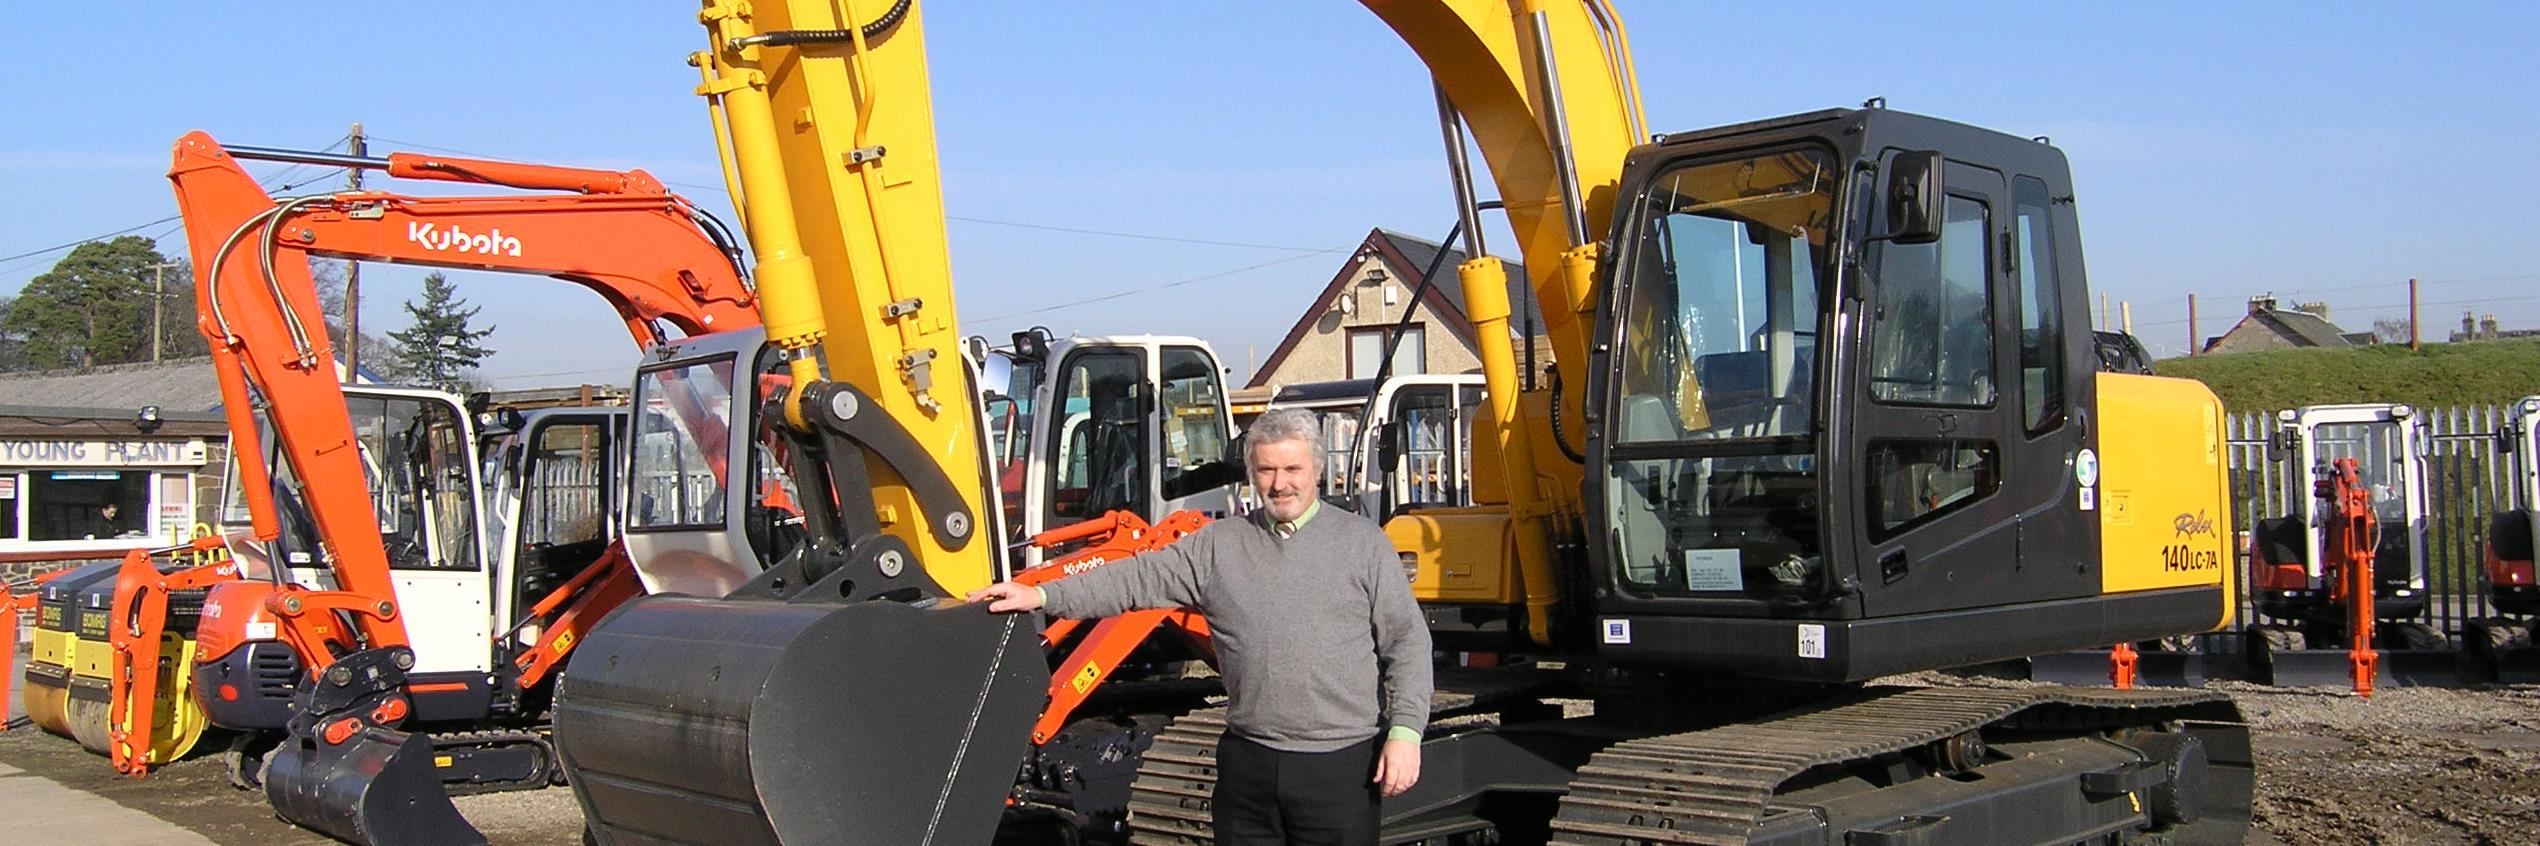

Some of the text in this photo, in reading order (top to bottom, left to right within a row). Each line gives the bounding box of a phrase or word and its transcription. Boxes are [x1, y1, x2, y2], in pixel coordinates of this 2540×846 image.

[408, 221, 522, 257] Kubota
[3, 440, 188, 462] YOUNG PLANT
[1063, 555, 1105, 576] Kubota
[1801, 639, 1815, 655] 101
